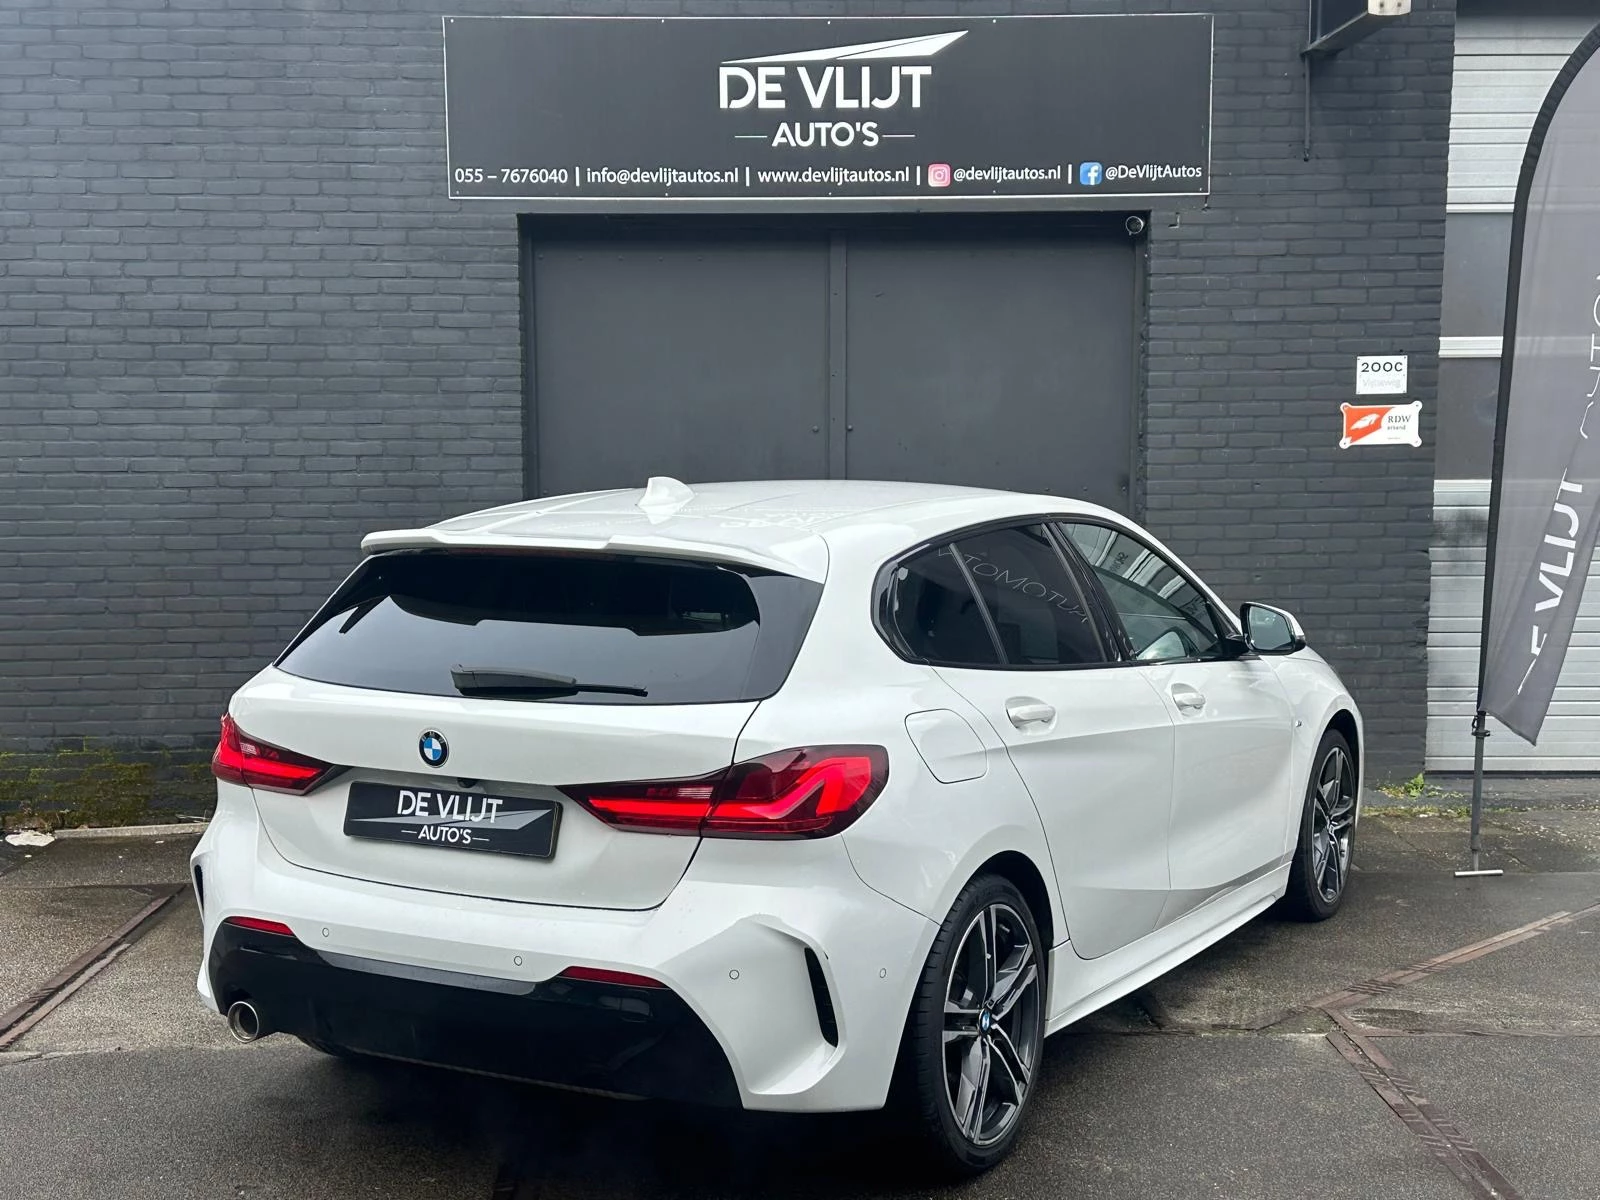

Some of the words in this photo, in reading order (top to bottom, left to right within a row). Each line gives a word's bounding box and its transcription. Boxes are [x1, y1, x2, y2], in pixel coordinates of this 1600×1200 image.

[719, 66, 786, 109] DE
[796, 66, 932, 109] VLIJT
[772, 121, 879, 147] AUTO'S
[454, 168, 483, 184] 055
[500, 168, 568, 184] 7676040
[586, 166, 739, 187] info@devlijtautos.nl
[757, 166, 910, 187] www.devlijtautos.nl
[953, 165, 1061, 184] @devlijtautos.nl
[1105, 164, 1202, 182] @DeVlijtAutos
[1388, 415, 1411, 423] RDW
[1534, 467, 1583, 613] VLIJT
[397, 790, 431, 817] DE
[437, 793, 503, 823] VLIJT
[418, 825, 472, 844] AUTO'S
